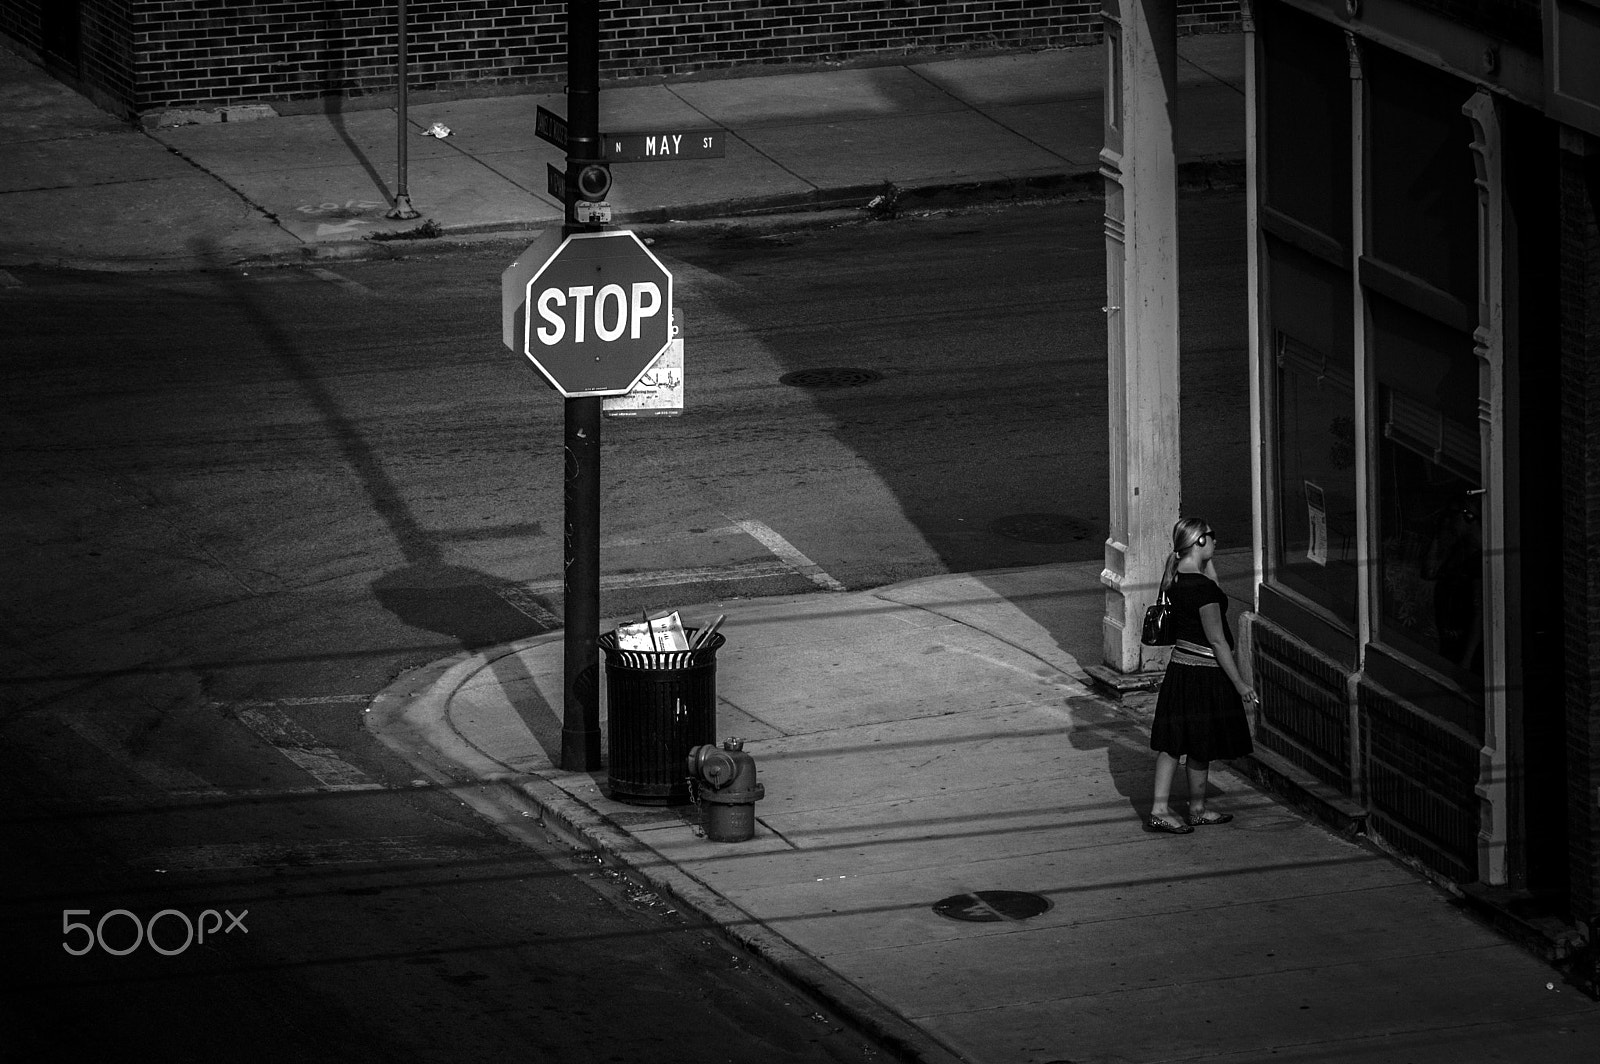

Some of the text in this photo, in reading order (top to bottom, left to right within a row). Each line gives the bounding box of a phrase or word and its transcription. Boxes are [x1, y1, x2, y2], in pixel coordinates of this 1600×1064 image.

[615, 134, 712, 156] N MAY ST
[536, 281, 662, 346] STOP
